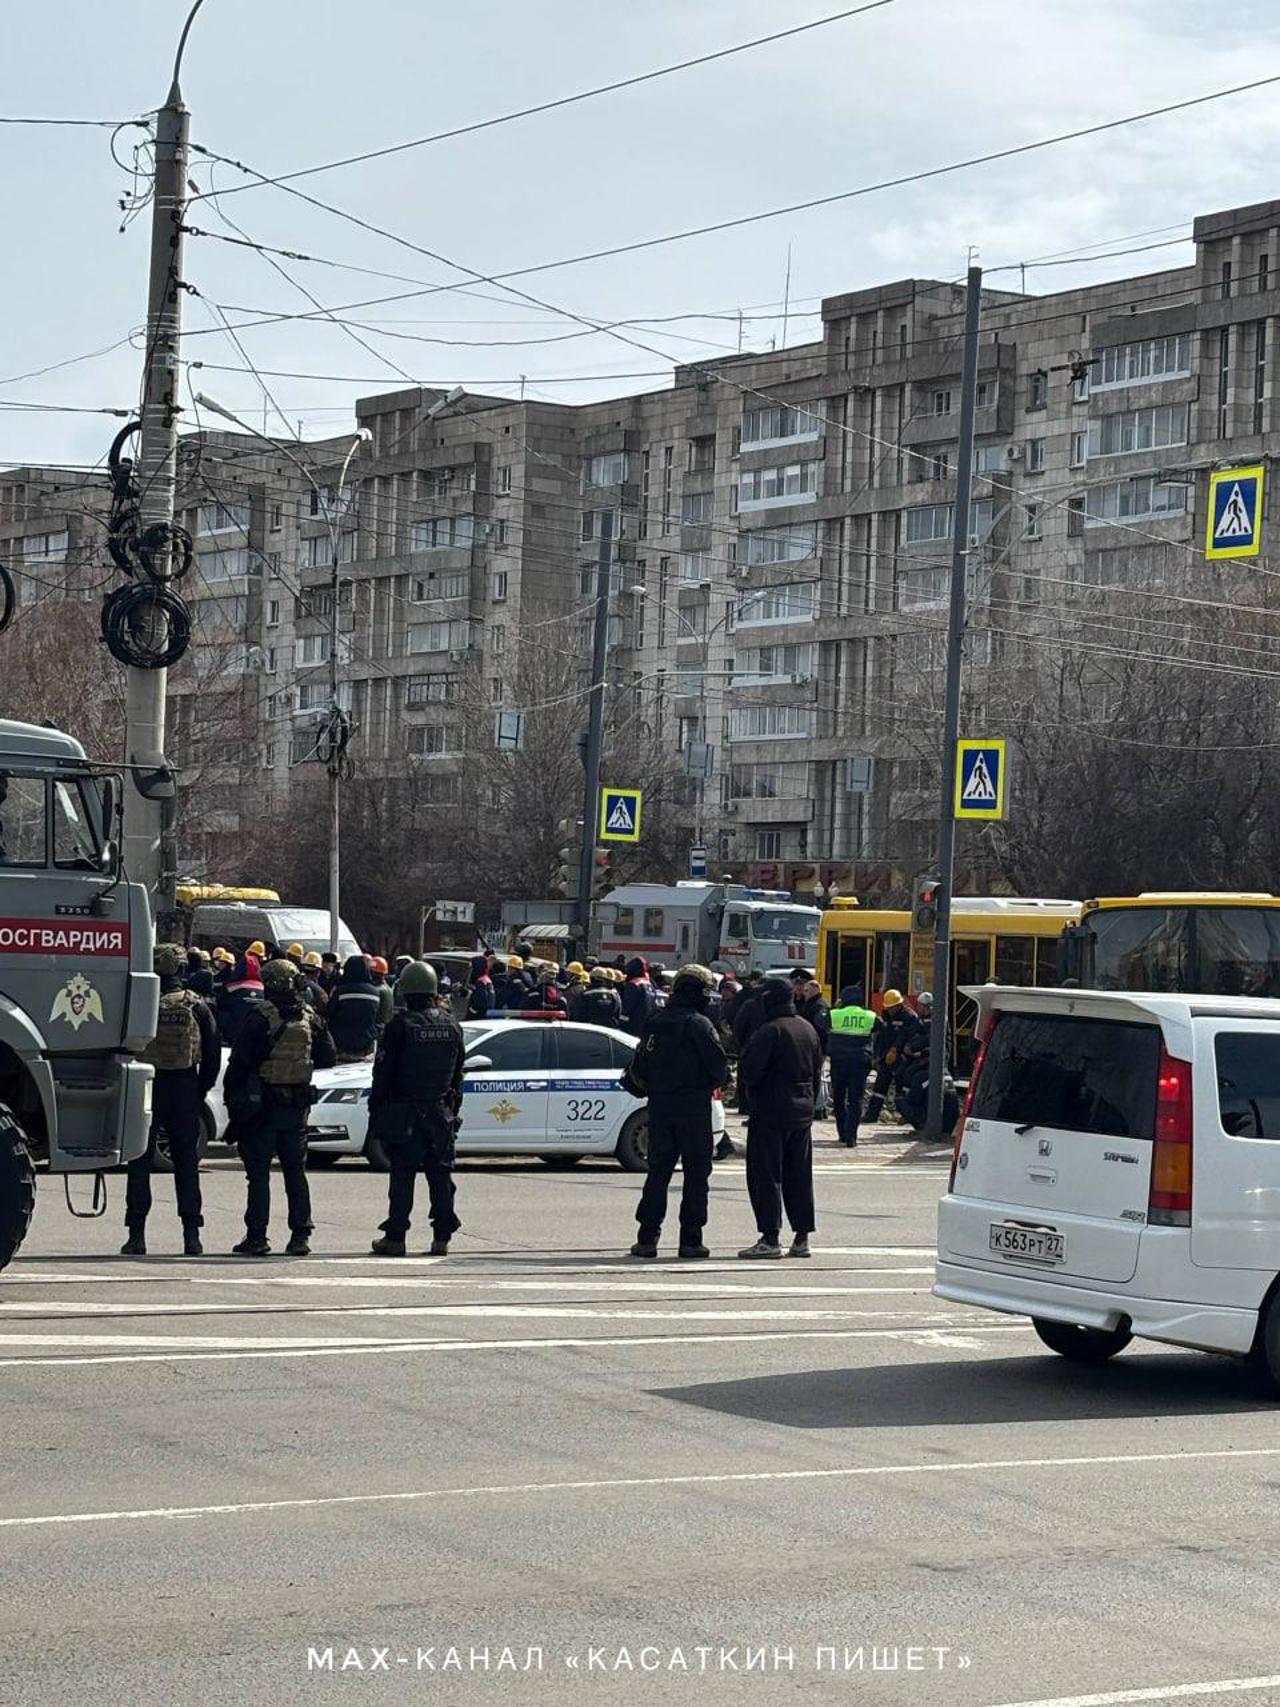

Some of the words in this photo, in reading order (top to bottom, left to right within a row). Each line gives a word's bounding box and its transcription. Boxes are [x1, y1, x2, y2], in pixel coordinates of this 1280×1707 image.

[0, 928, 122, 951] ОСГВАРДИЯ
[841, 1016, 864, 1028] ДПС
[473, 1081, 525, 1092] ПОЛИЦИЯ
[566, 1099, 606, 1121] 322
